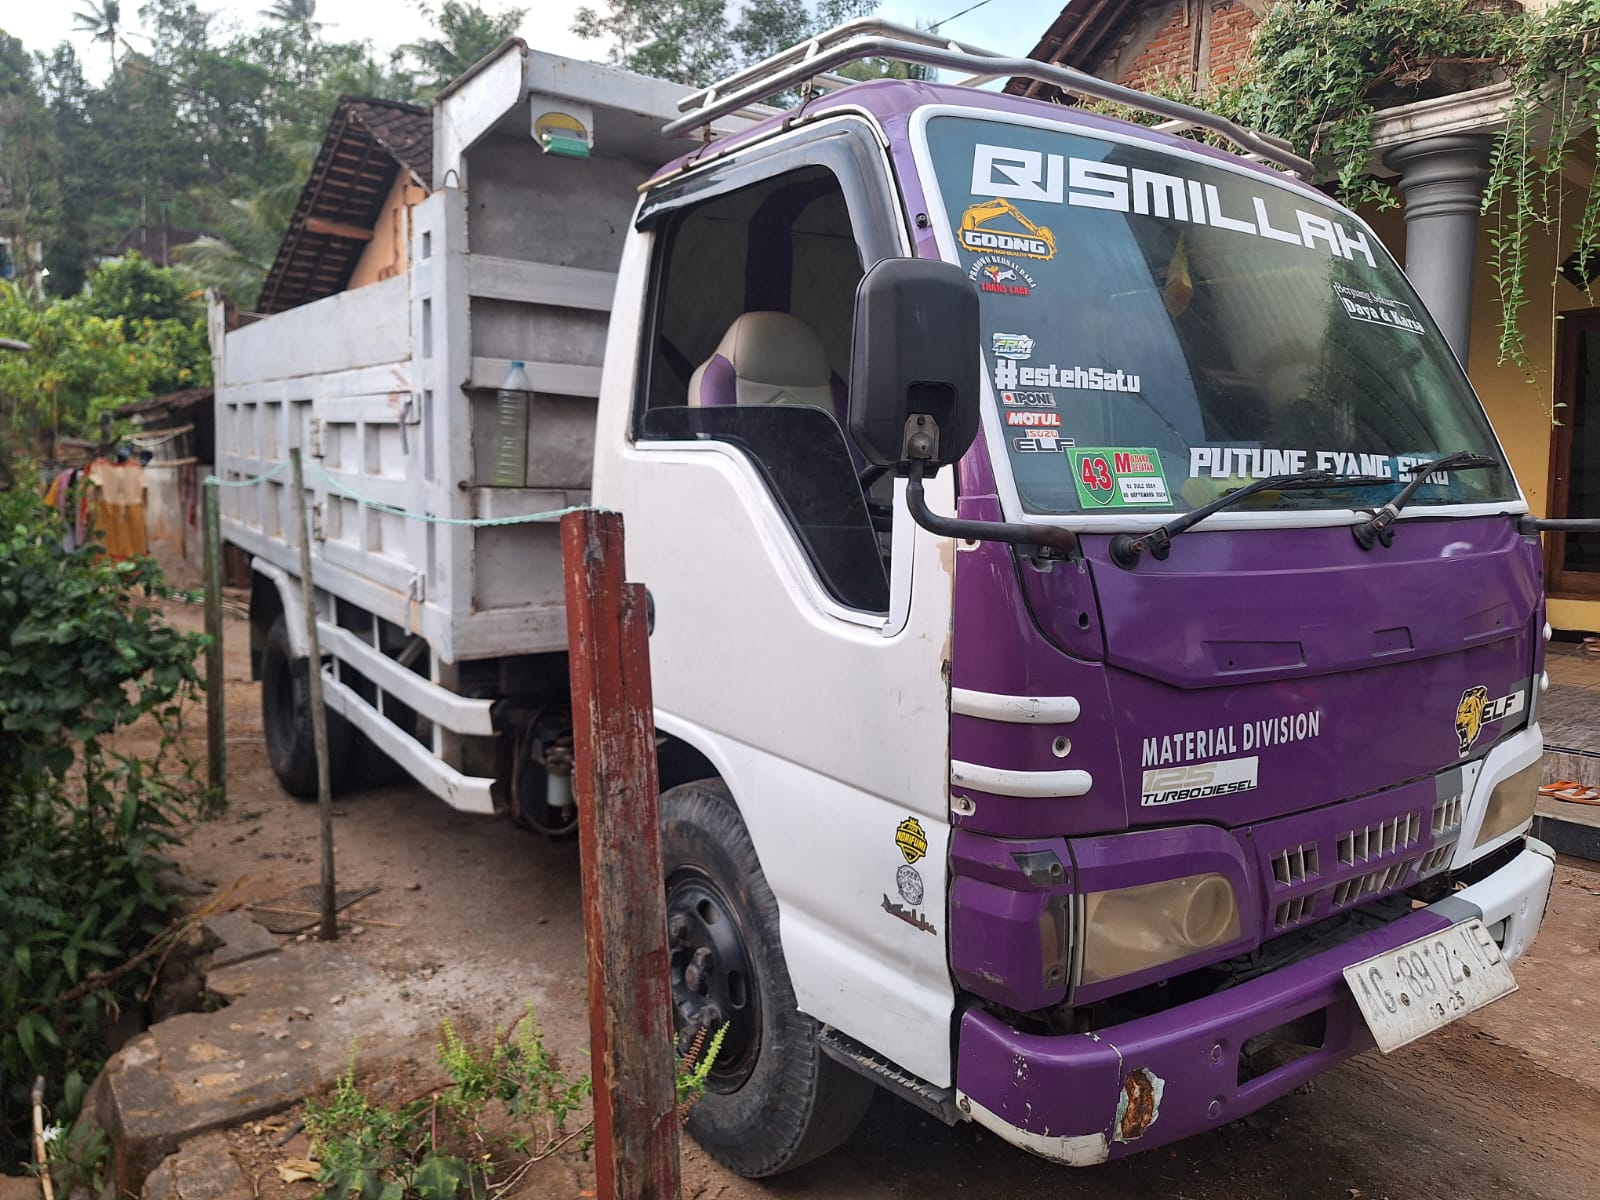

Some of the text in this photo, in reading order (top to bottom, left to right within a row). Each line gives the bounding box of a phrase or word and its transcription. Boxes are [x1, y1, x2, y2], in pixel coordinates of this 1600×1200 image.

[970, 143, 1378, 268] BISMILLAH
[1342, 297, 1380, 320] Daya
[1379, 306, 1392, 323] &
[994, 359, 1141, 393] #estehSatu
[1008, 412, 1061, 426] MOTUL
[1026, 430, 1058, 438] ISUZU
[1014, 438, 1075, 452] ELF
[1082, 457, 1112, 491] 43
[1189, 447, 1307, 478] PUTUNE
[1316, 450, 1392, 478] EYANG
[1480, 694, 1516, 724] ELF
[1141, 710, 1320, 768] MATERIAL DIVISION
[1143, 762, 1218, 793] 125
